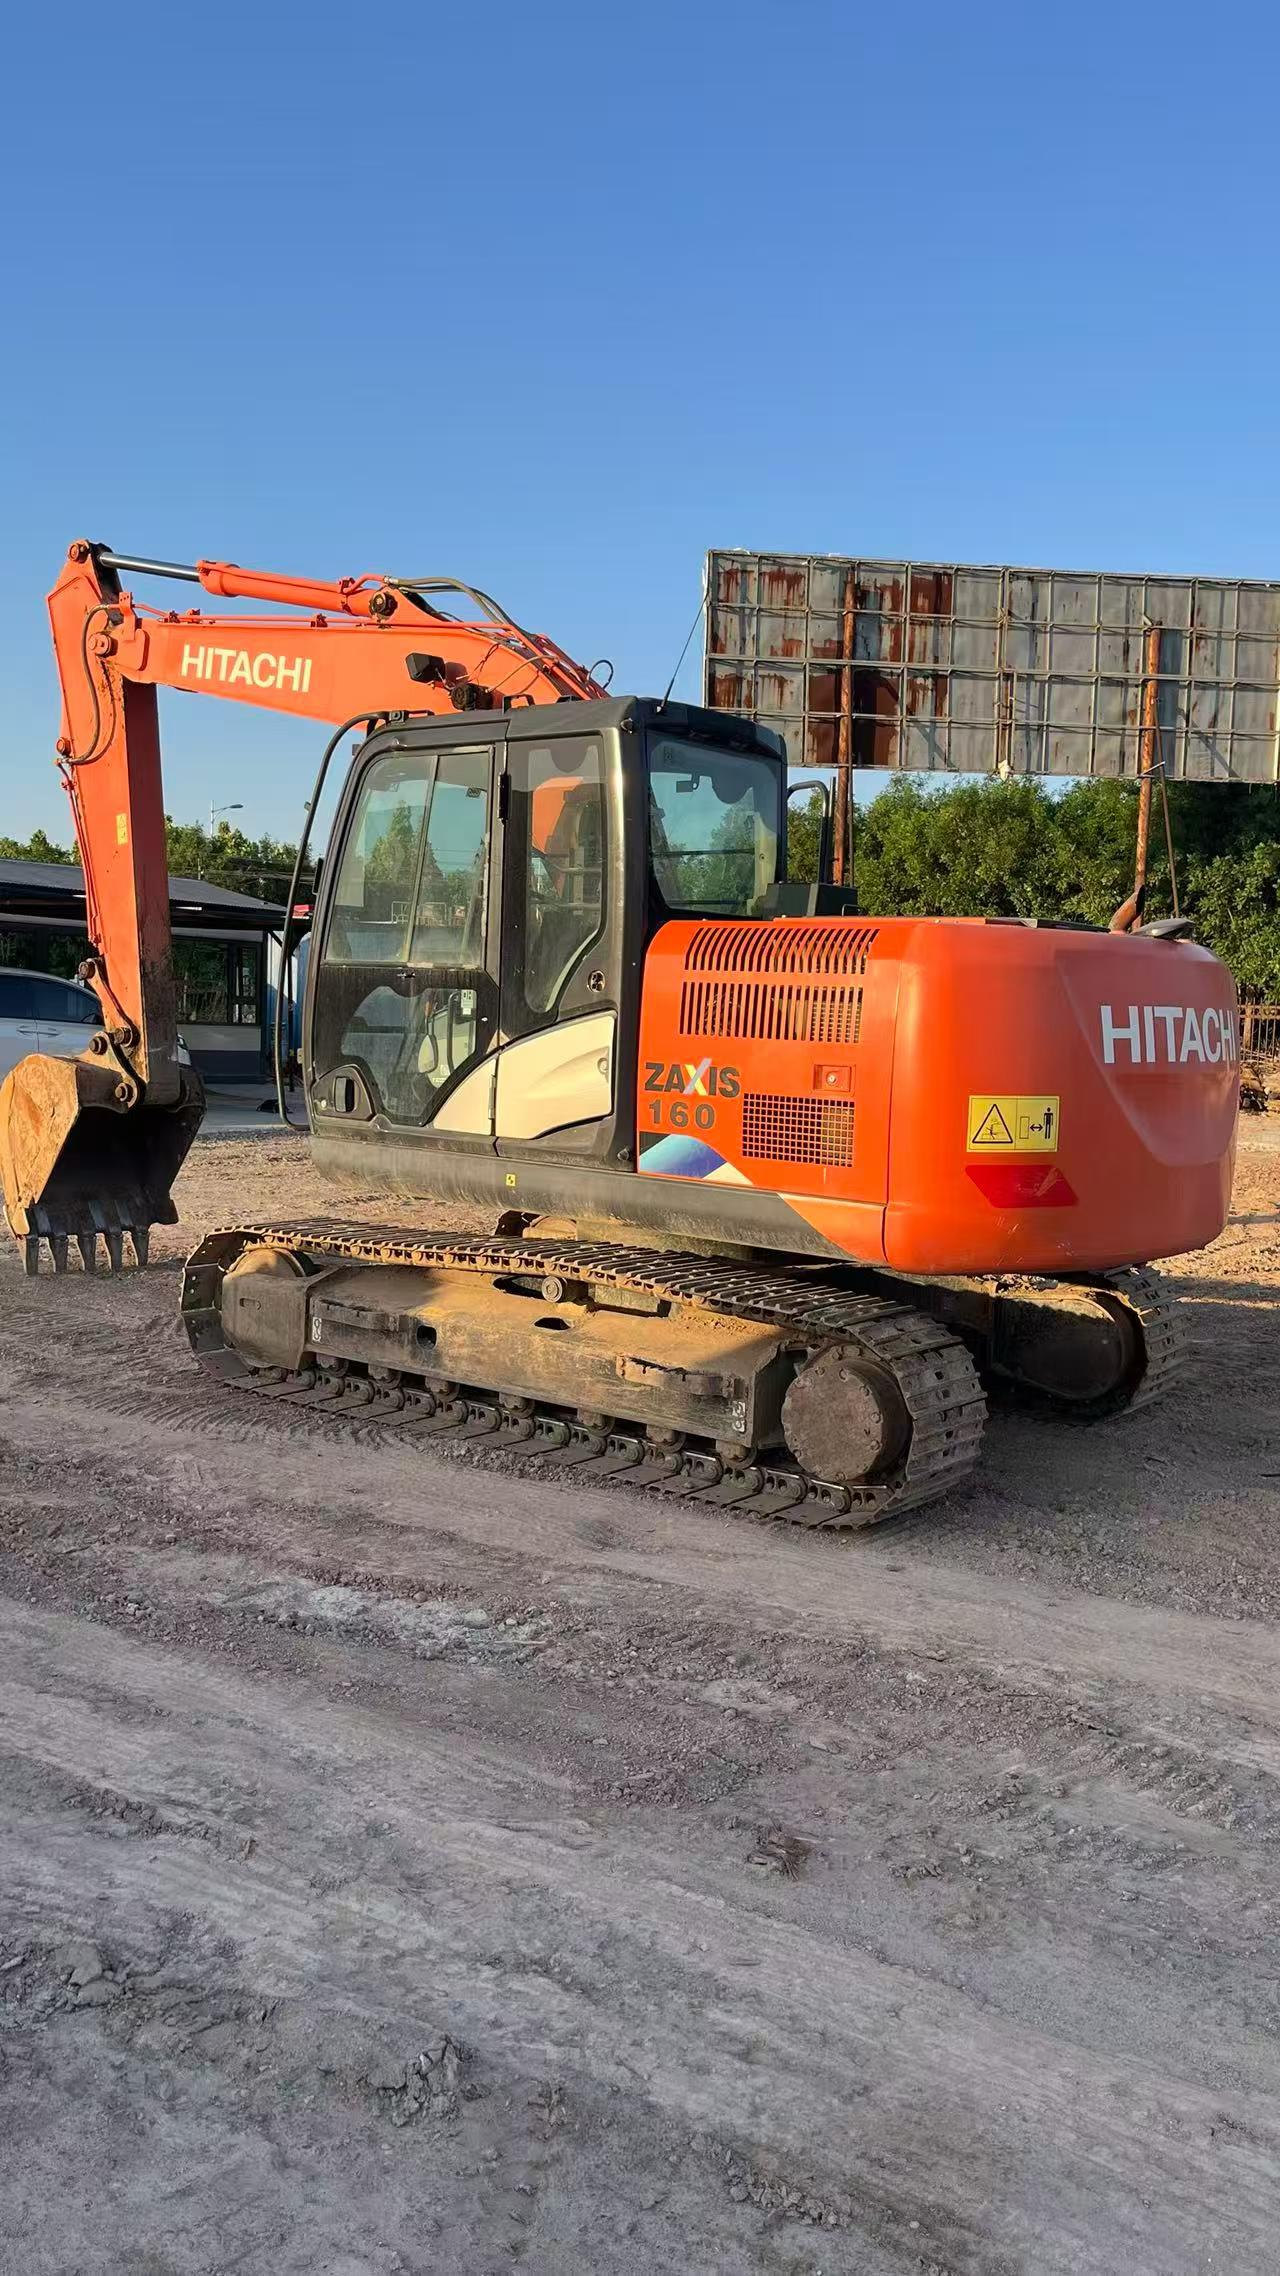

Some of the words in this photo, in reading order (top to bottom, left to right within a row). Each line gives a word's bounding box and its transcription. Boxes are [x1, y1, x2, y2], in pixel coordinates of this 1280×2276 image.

[181, 644, 312, 693] HITACHI
[1100, 1005, 1237, 1063] HITACHI
[645, 1058, 740, 1098] ZAXIS
[649, 1099, 715, 1129] 160
